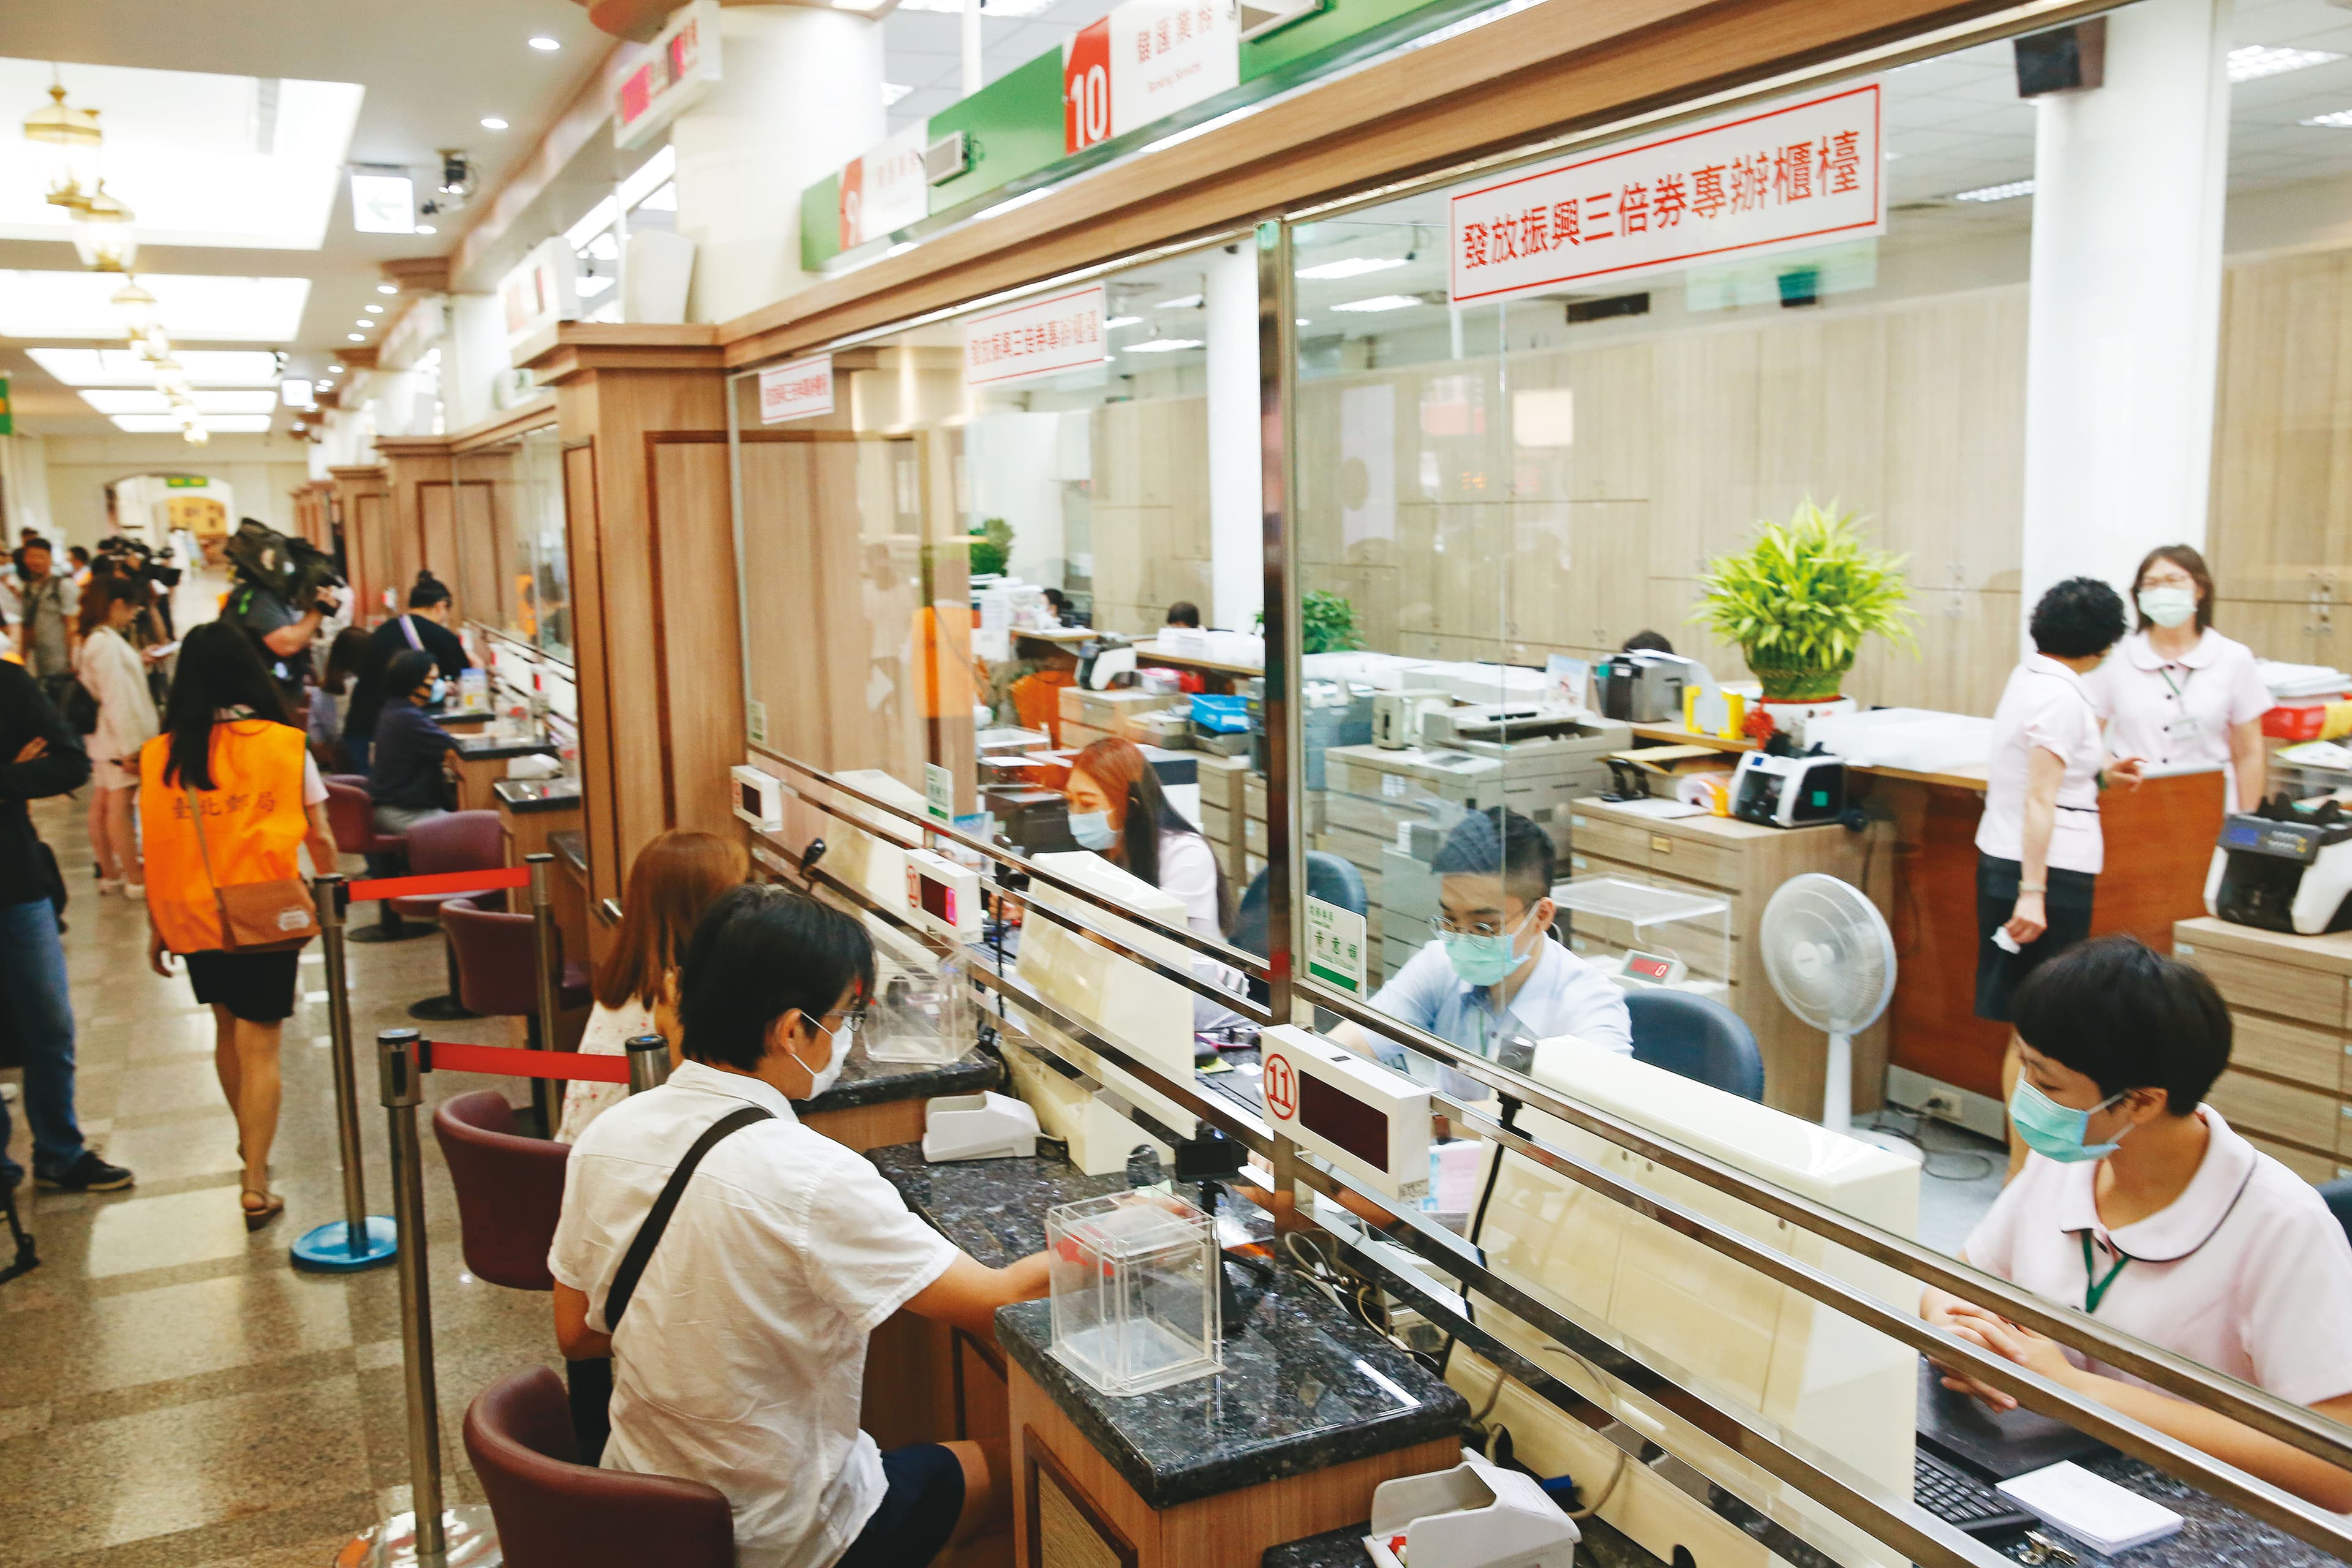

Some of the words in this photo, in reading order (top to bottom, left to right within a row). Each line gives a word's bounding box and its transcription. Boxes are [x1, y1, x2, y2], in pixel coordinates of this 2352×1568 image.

[1070, 64, 1107, 149] 10
[1464, 129, 1861, 269] 發放振興三倍券專辦櫃檯
[1653, 963, 1668, 978] 0
[1268, 1063, 1294, 1112] 11
